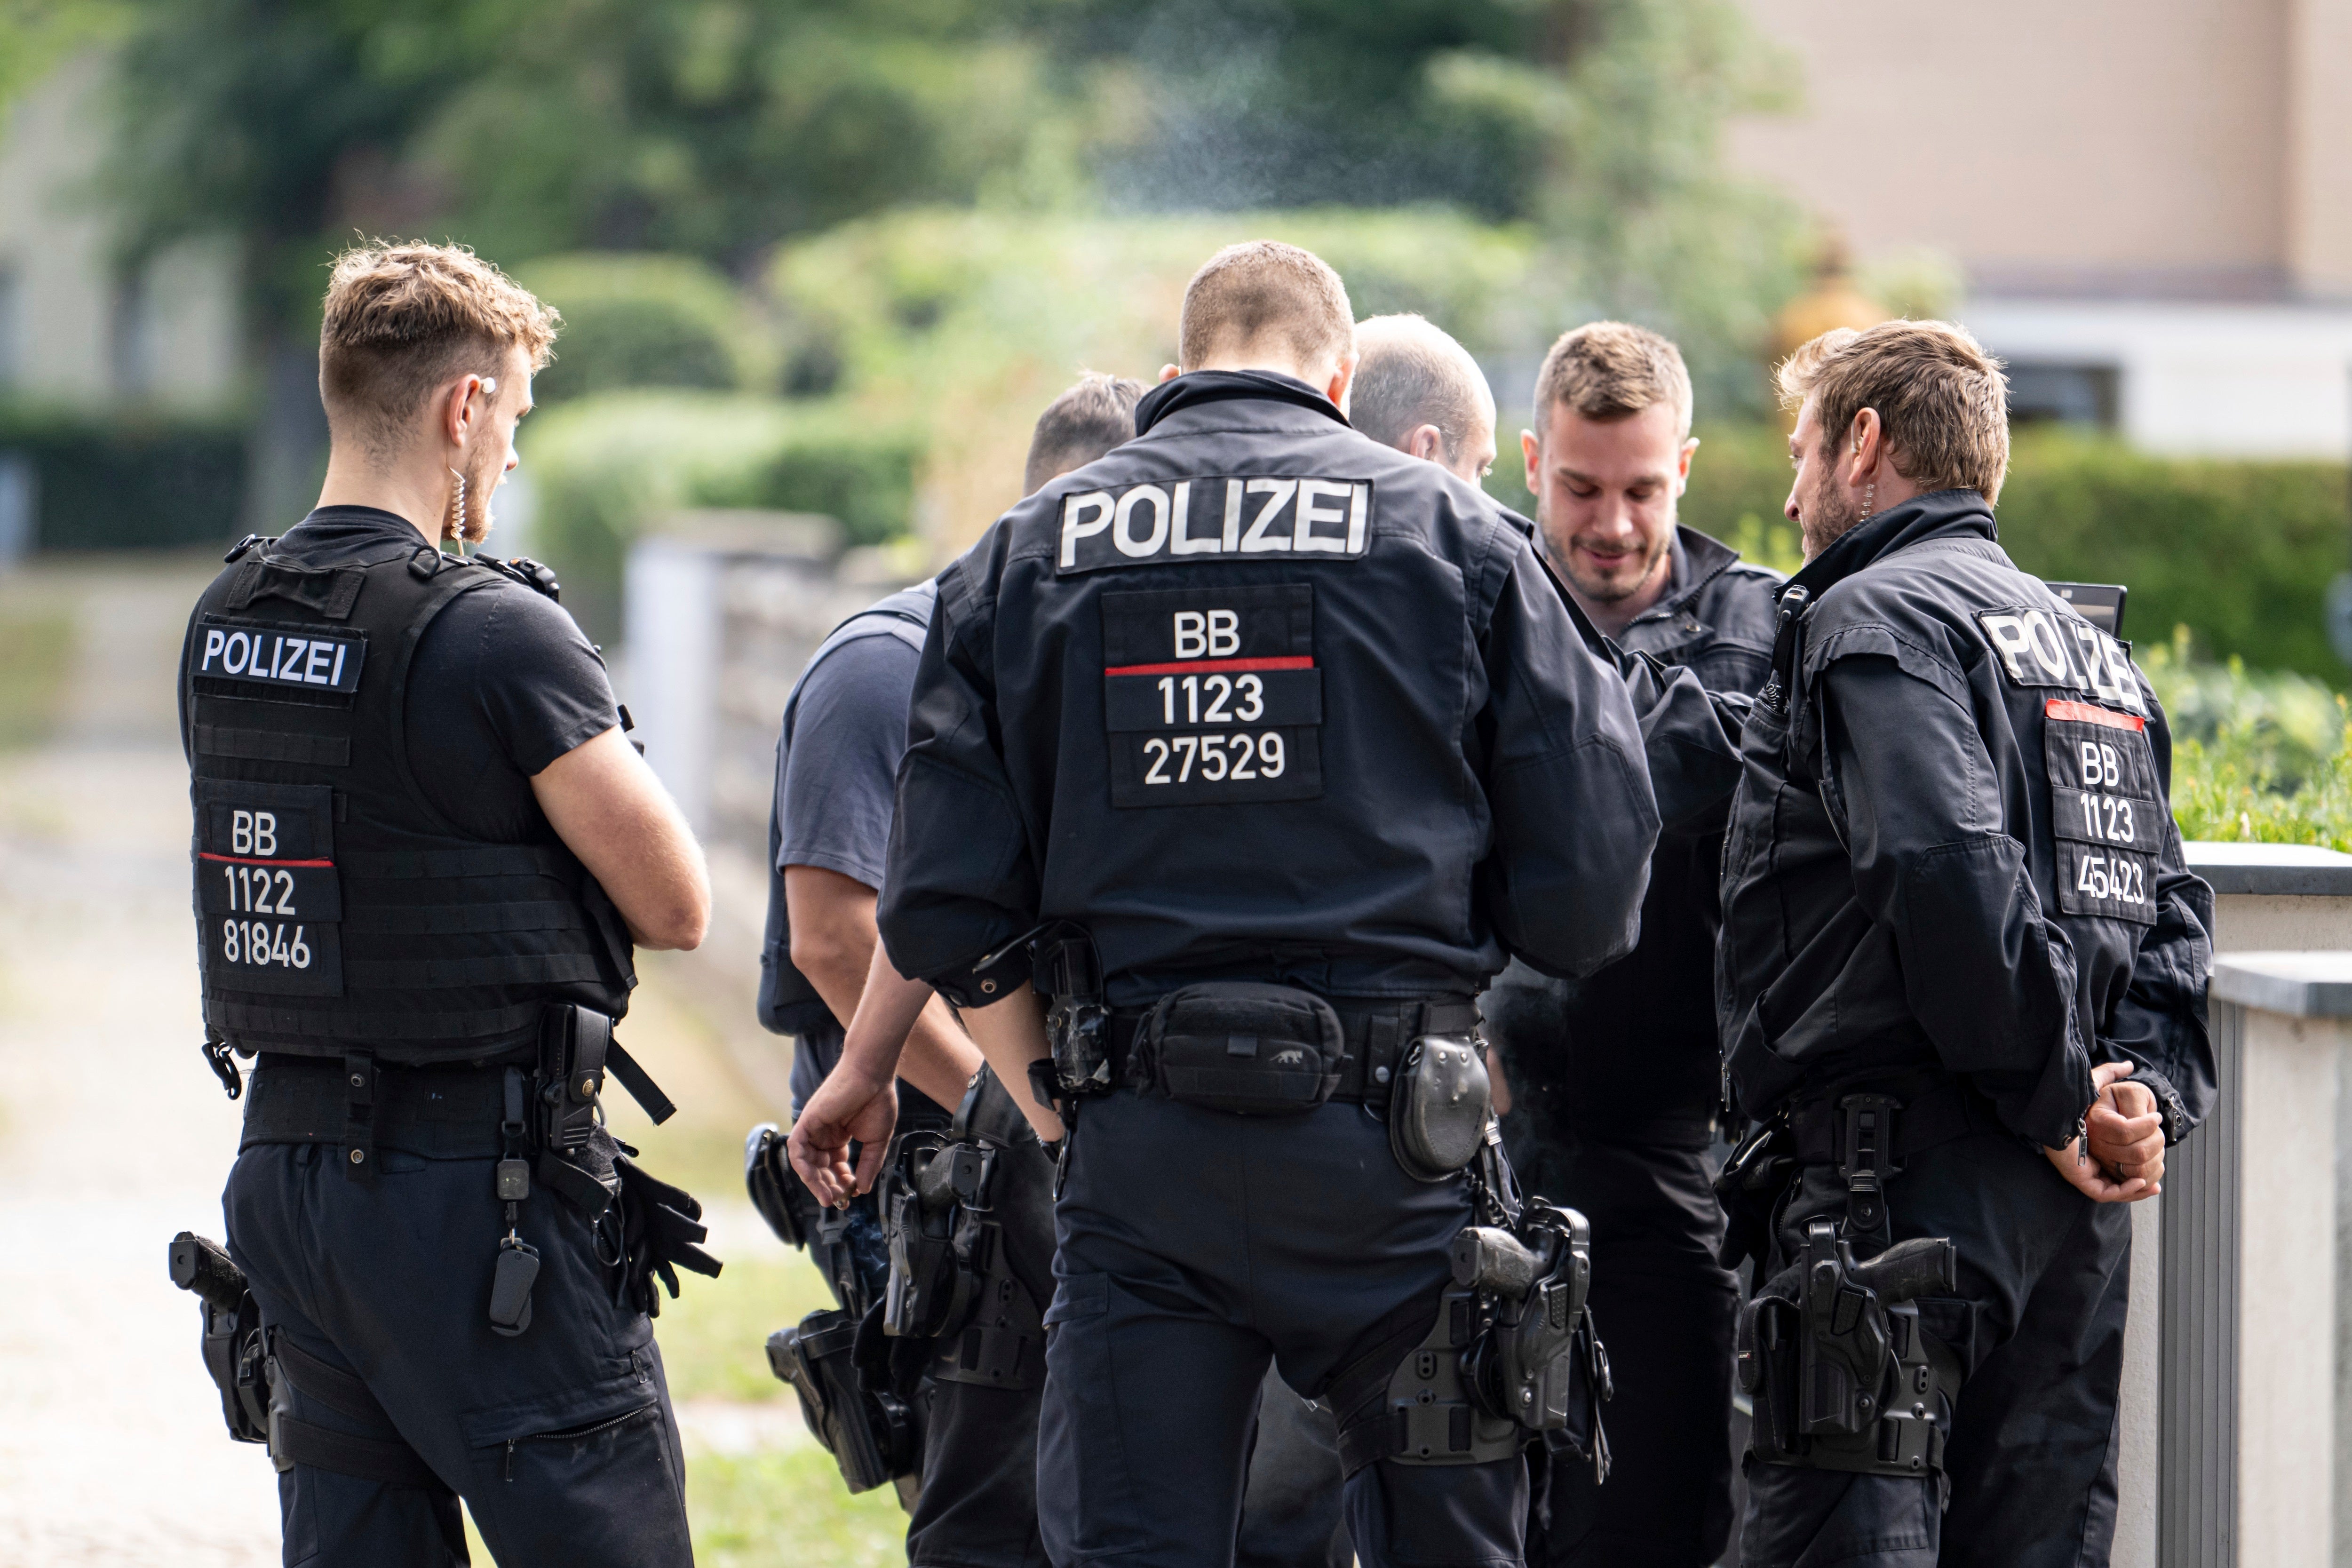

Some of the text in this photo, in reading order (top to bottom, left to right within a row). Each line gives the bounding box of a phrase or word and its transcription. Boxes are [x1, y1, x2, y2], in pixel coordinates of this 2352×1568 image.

[1060, 479, 1368, 568] POLIZEI
[201, 630, 346, 685] POLIZEI
[1174, 609, 1240, 658] BB
[1158, 674, 1264, 724] 1123
[1144, 732, 1285, 784] 27529
[2082, 741, 2119, 787] BB
[232, 810, 277, 856] BB
[2081, 793, 2134, 843] 1123
[225, 866, 295, 915] 1122
[2078, 855, 2145, 904] 45423
[224, 919, 310, 969] 81846
